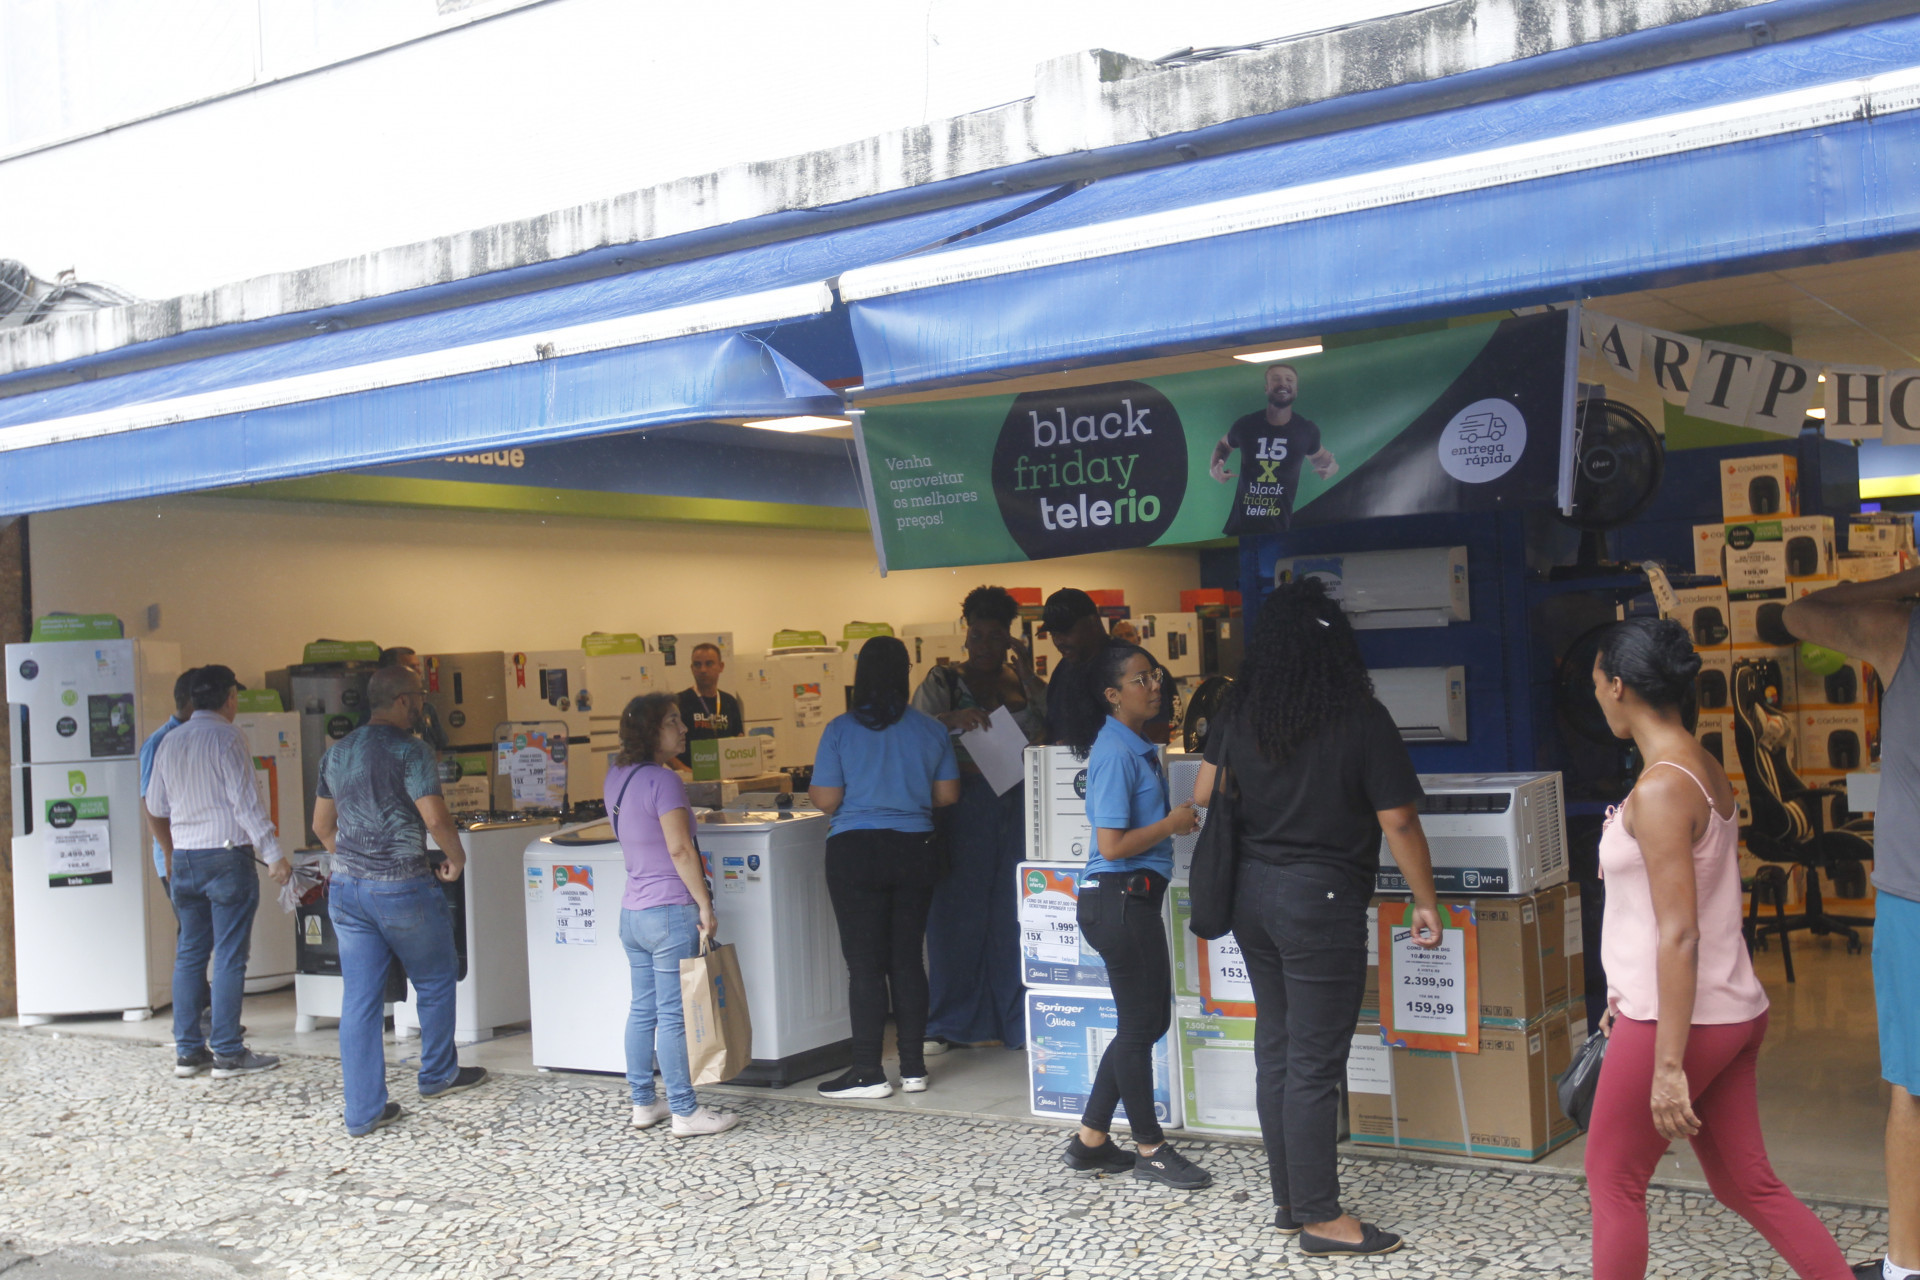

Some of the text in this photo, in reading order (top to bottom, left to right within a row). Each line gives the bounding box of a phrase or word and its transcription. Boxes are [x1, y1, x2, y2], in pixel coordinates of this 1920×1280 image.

[1029, 399, 1152, 447] black
[1255, 437, 1288, 460] 15
[1451, 442, 1505, 458] entrega
[885, 455, 932, 471] Venha
[1465, 451, 1512, 467] rápida
[1014, 449, 1140, 491] friday
[1256, 460, 1281, 482] X
[1738, 463, 1778, 473] cadence
[889, 471, 964, 491] aproveitar
[1250, 482, 1284, 495] black
[894, 490, 978, 508] os melhores
[1243, 493, 1279, 506] friday
[1040, 488, 1160, 530] telerio
[1246, 504, 1280, 516] telerio
[896, 511, 944, 531] preços!
[1783, 524, 1816, 533] adence
[1683, 594, 1722, 604] cadence
[1816, 715, 1859, 726] cadence
[693, 752, 718, 761] Consul
[724, 746, 756, 760] Consul
[1481, 875, 1504, 884] WI-FI
[1050, 922, 1074, 931] 1.999
[1026, 932, 1042, 941] 15X
[1059, 935, 1074, 944] 133
[1404, 976, 1454, 988] 2.399,90
[1035, 1001, 1085, 1014] Springer
[1406, 1001, 1454, 1015] 159,99
[1047, 1015, 1076, 1027] Midea
[1185, 1022, 1205, 1030] 7.500
